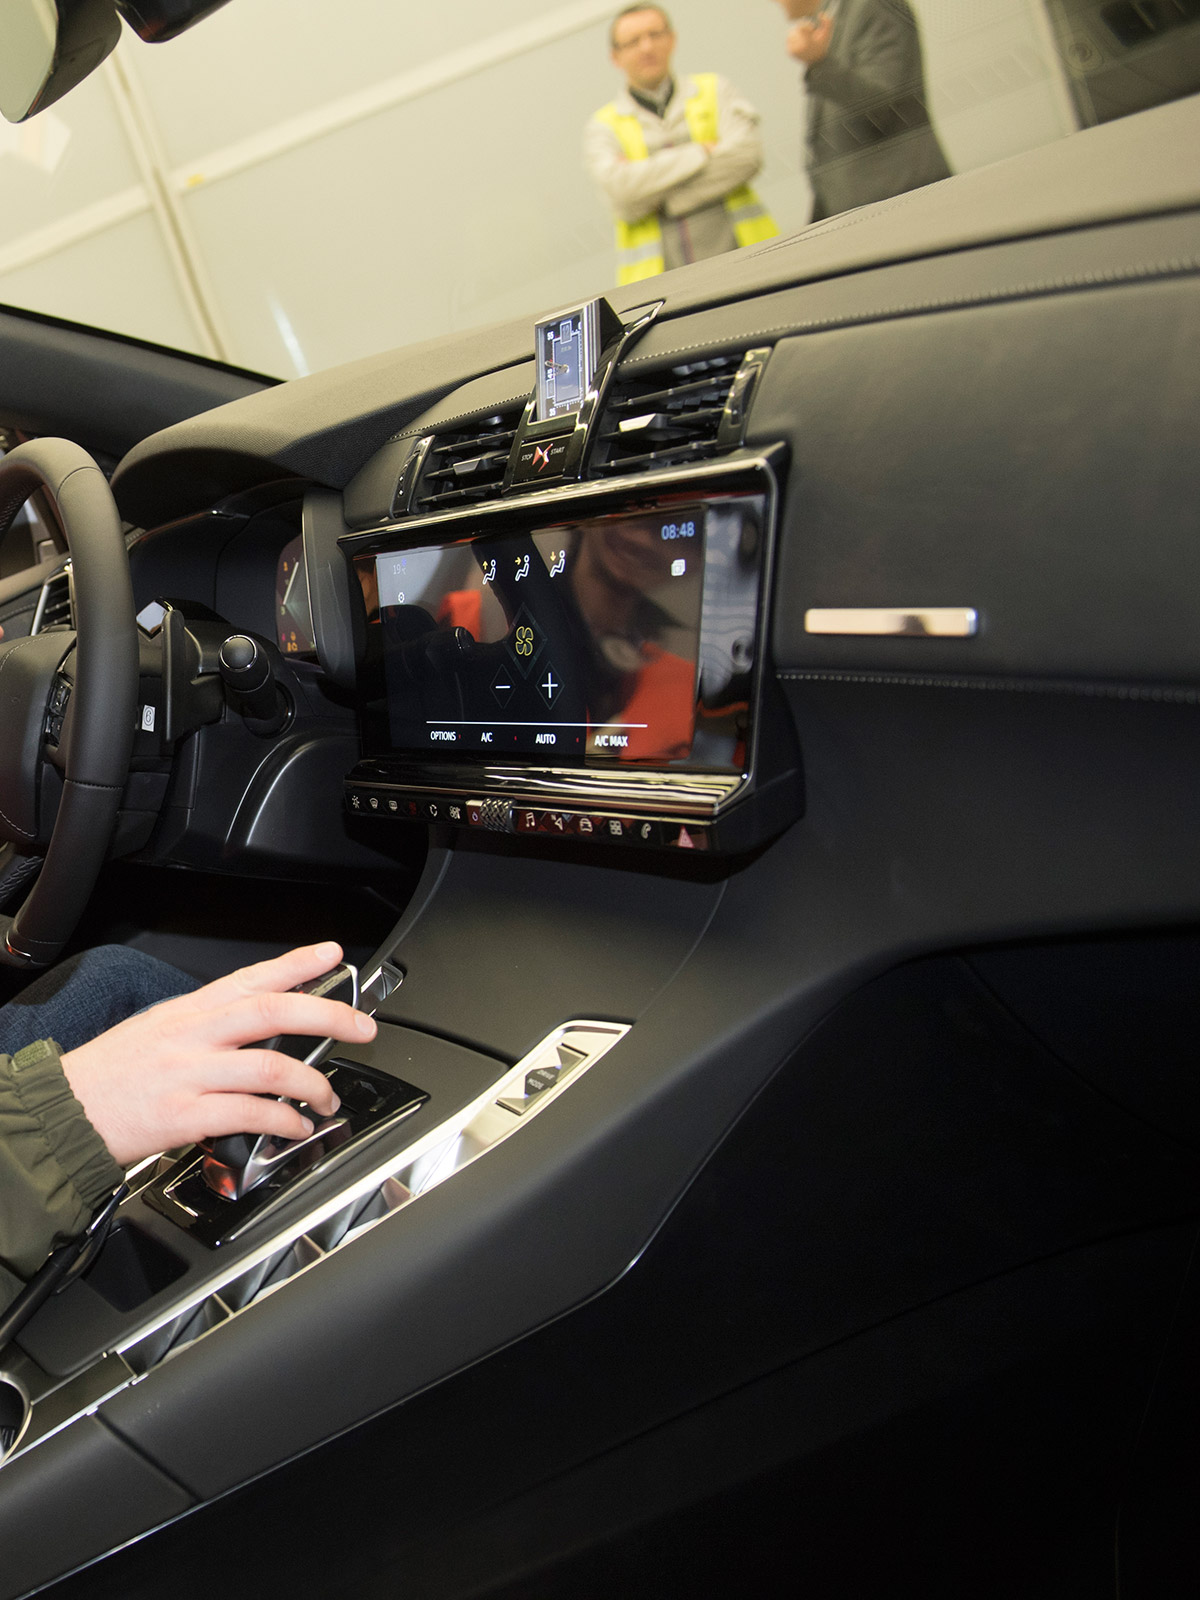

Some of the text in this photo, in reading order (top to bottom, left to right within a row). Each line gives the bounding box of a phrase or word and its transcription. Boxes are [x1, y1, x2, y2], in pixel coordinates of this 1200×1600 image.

[521, 446, 565, 461] STOP START
[661, 521, 695, 540] 08:48
[430, 730, 457, 742] OPTIONS
[481, 732, 493, 743] A/C
[535, 733, 556, 745] AUTO
[594, 734, 628, 747] A/C MAX
